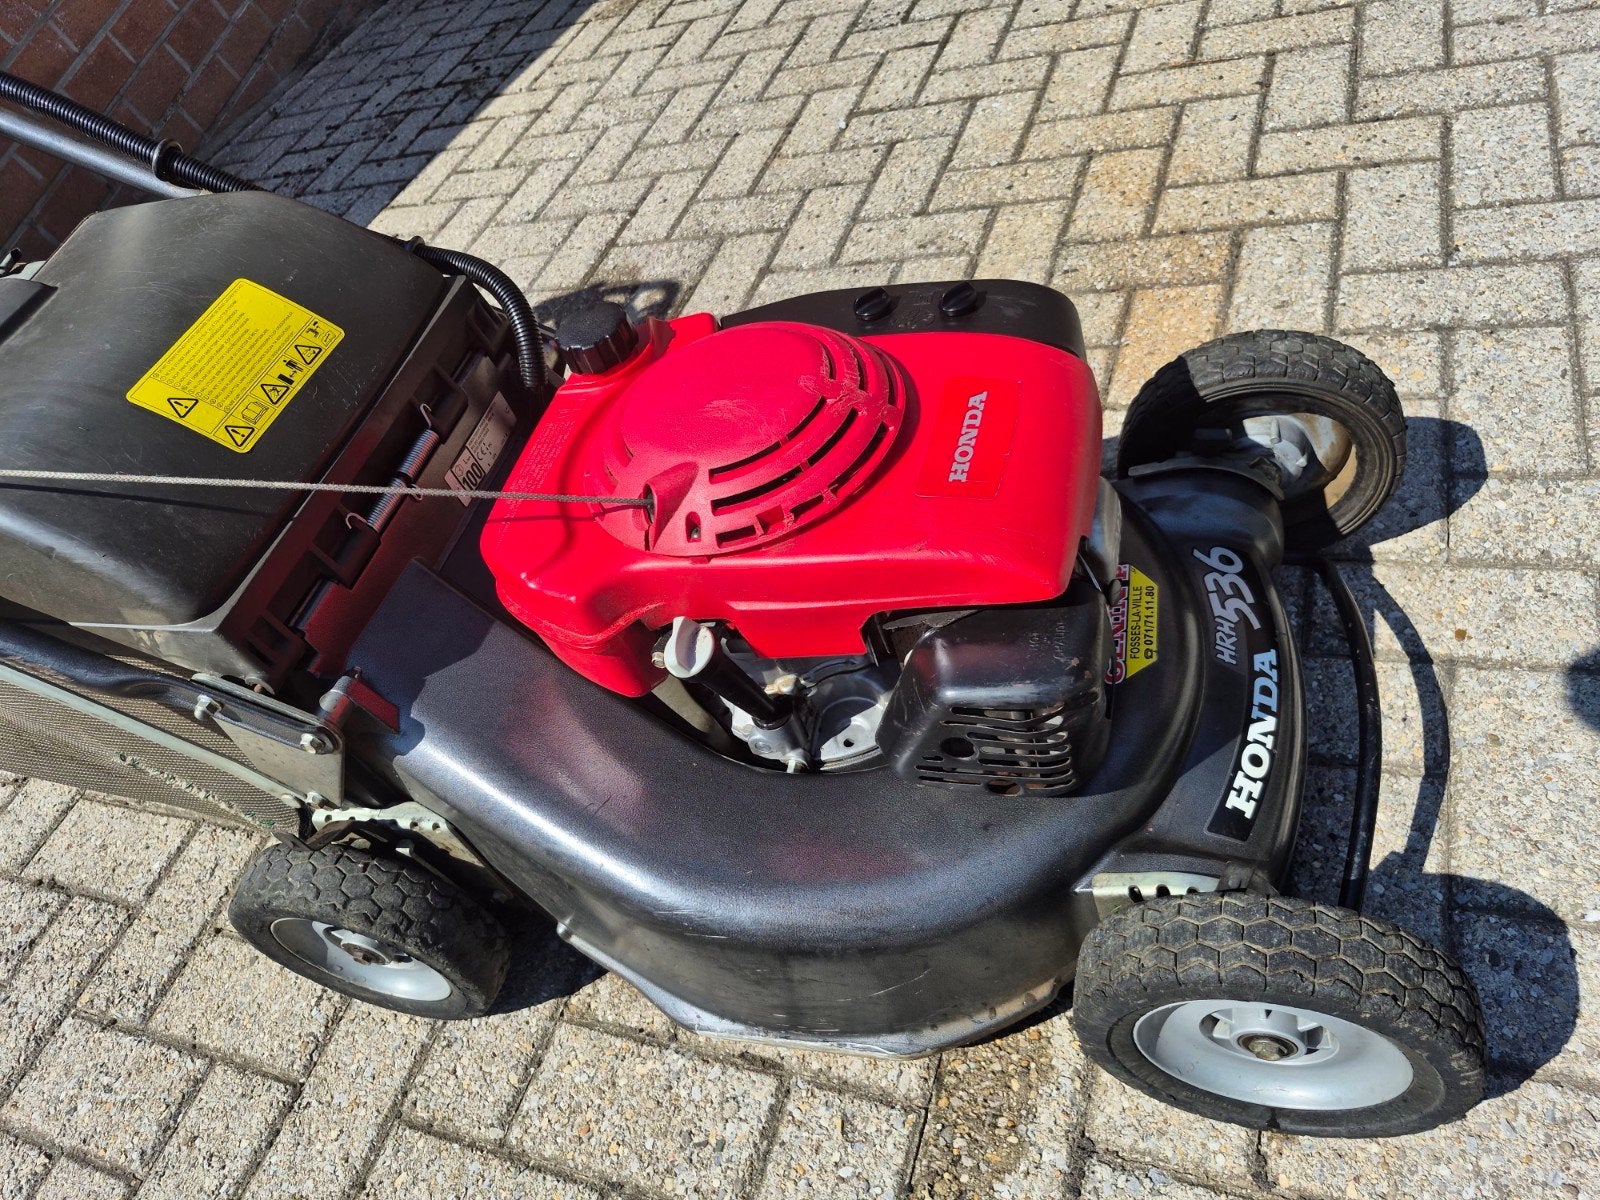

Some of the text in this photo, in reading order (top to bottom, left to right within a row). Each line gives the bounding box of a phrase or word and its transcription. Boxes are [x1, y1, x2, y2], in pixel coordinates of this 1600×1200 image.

[948, 391, 988, 483] HONDA
[461, 462, 484, 491] 100
[1130, 585, 1143, 660] FOSSES-LA-VILLE
[1144, 585, 1155, 646] 071/71.11.80
[1225, 649, 1278, 818] HONDA
